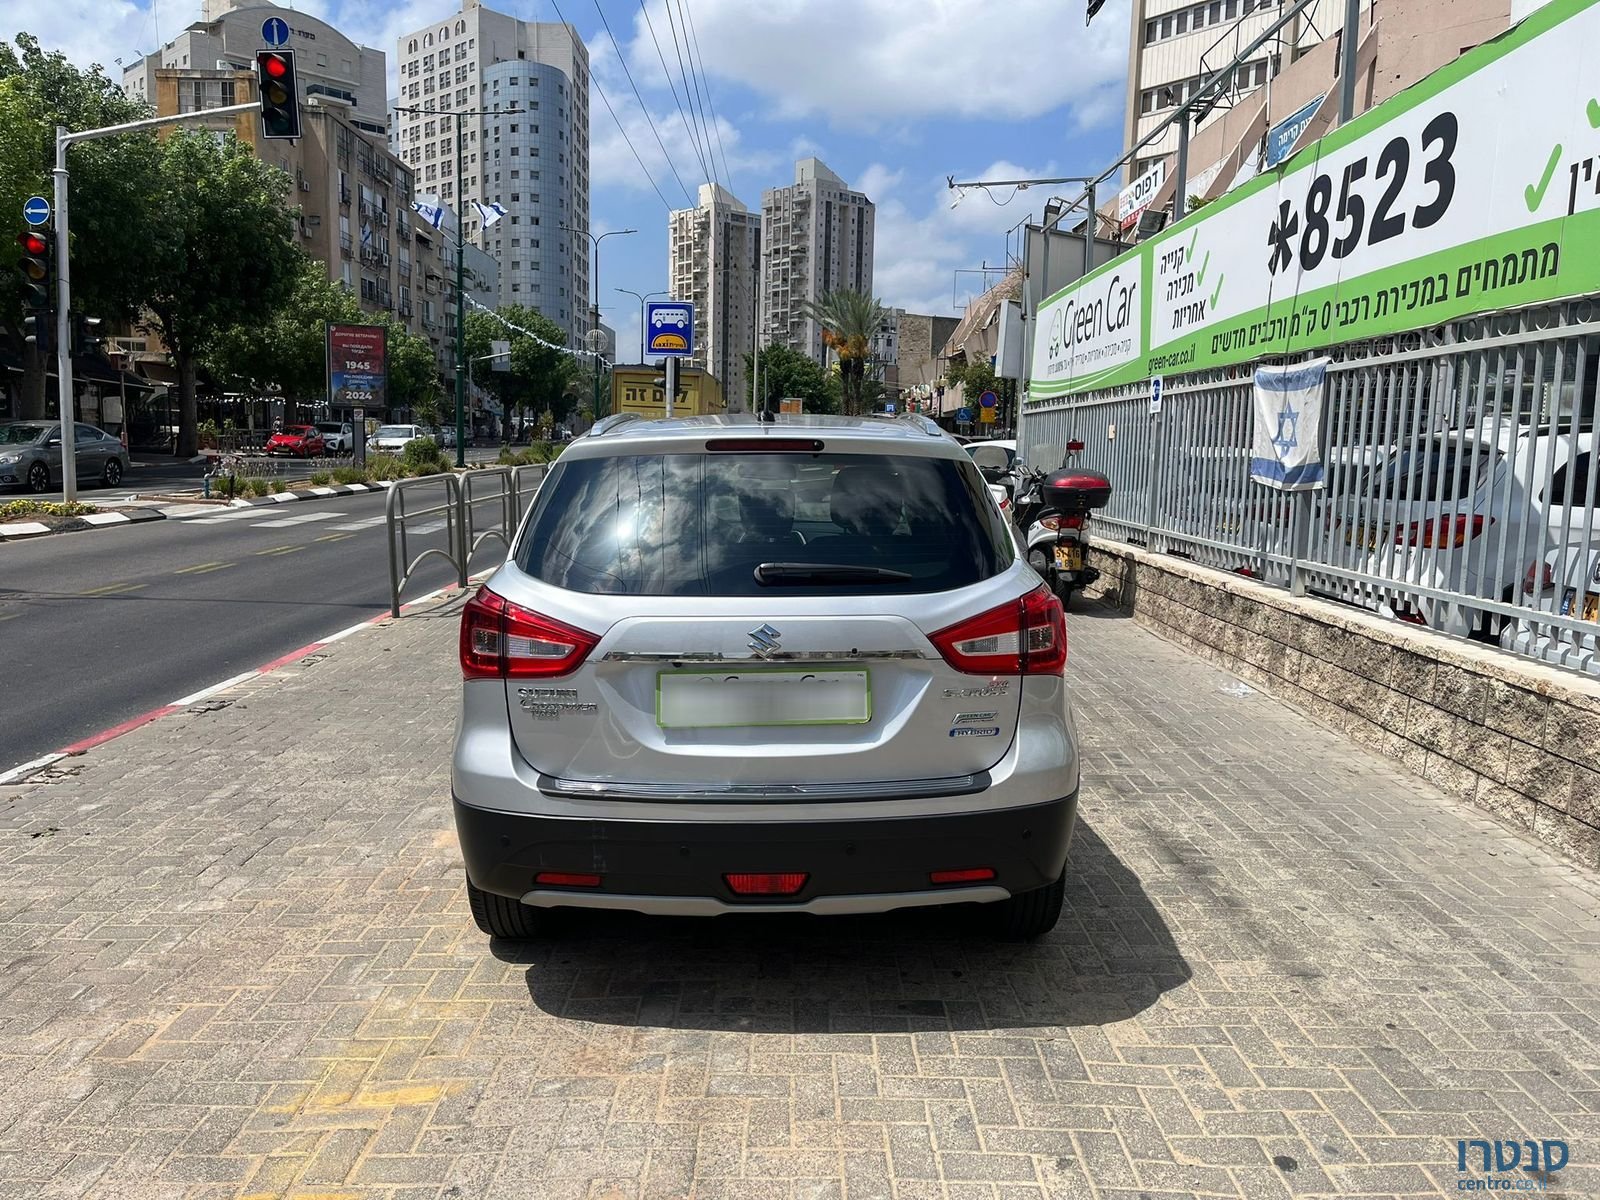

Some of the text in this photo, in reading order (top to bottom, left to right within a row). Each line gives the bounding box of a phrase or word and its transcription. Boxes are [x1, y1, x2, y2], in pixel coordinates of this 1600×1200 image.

[1279, 124, 1298, 147] קדימה
[1135, 170, 1158, 200] דפוס
[1568, 155, 1600, 216] ין
[1160, 246, 1184, 275] קנייה
[1456, 242, 1559, 298] מתמחים
[1166, 272, 1194, 301] מכירה
[1374, 273, 1448, 318] במכירת
[1063, 275, 1136, 349] Green Car
[1172, 299, 1206, 329] אחריות
[1321, 301, 1331, 330] 0
[1336, 295, 1370, 327] רכבי
[1211, 328, 1246, 355] חדשים
[1249, 316, 1287, 346] ורכבים
[345, 361, 370, 370] 1945
[1148, 343, 1196, 375] green-car.co.il
[345, 391, 373, 400] 2024
[625, 388, 647, 401] זה
